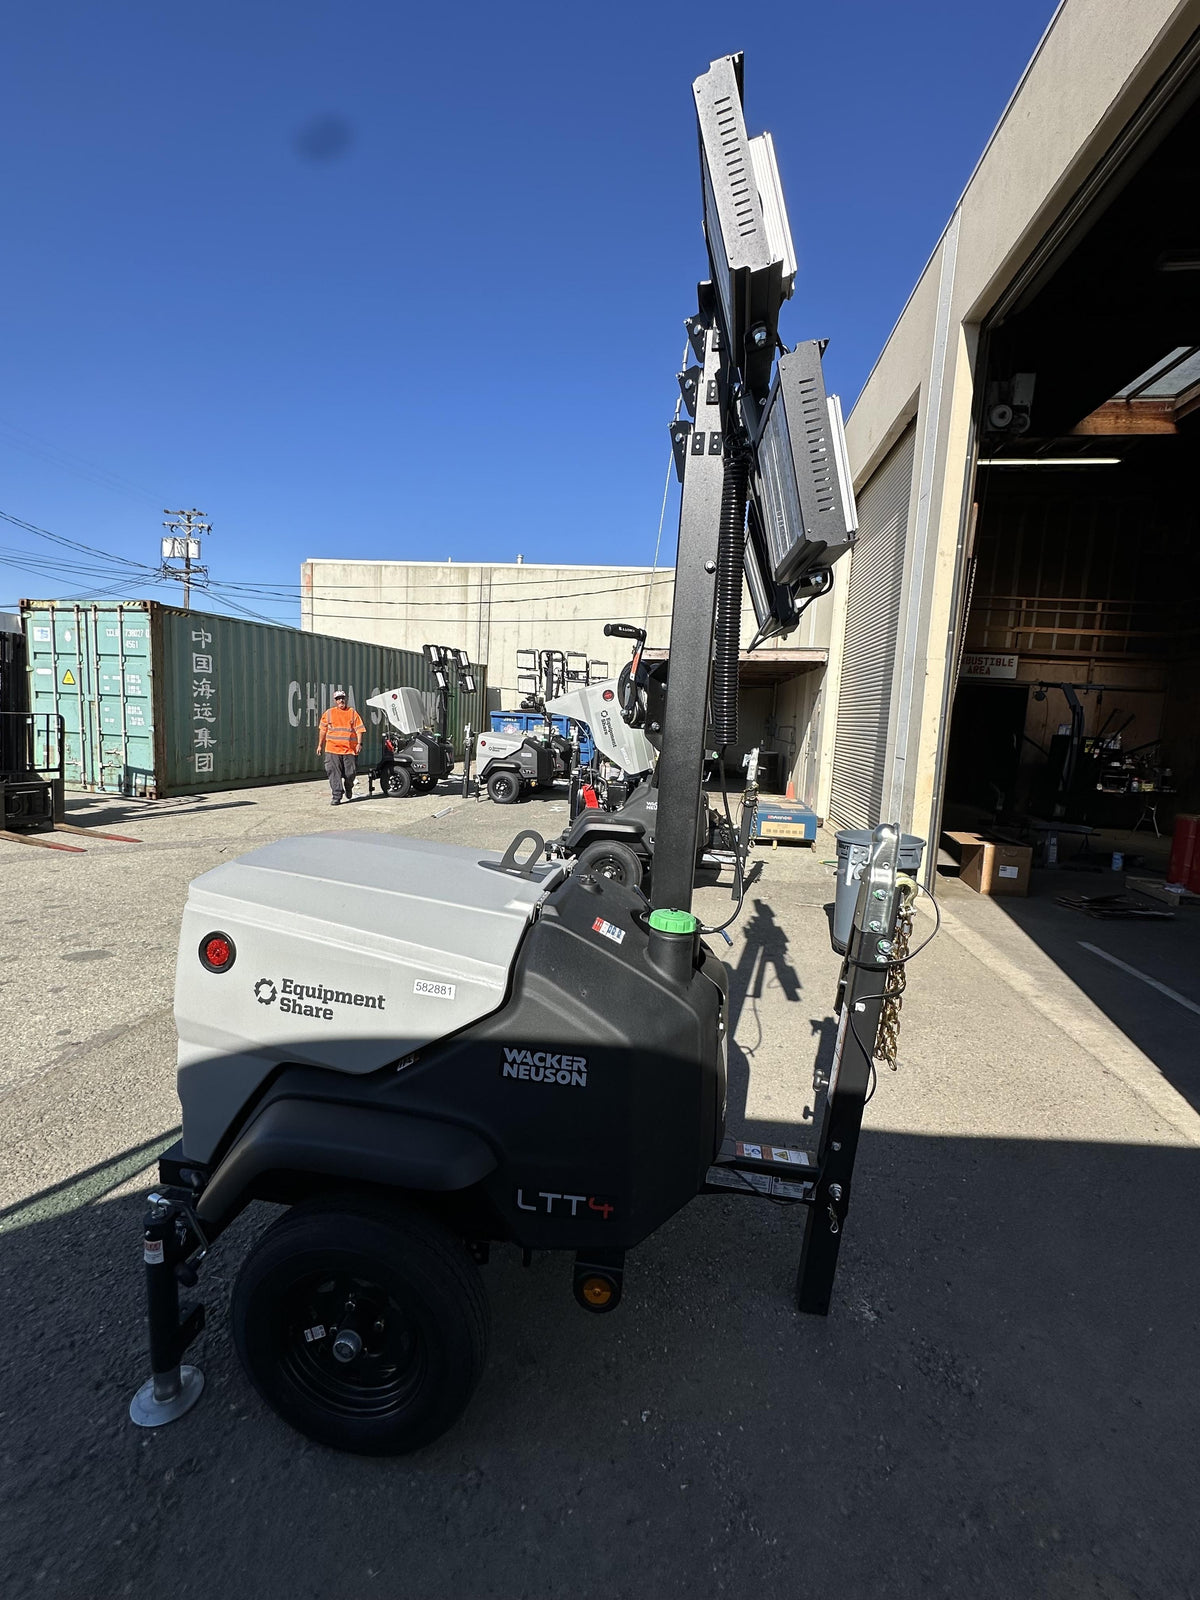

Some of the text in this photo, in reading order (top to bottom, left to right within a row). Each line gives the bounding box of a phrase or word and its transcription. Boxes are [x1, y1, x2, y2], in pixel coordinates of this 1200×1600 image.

[967, 665, 991, 676] AREA
[280, 978, 386, 1010] Equipment
[415, 981, 453, 996] 582881
[279, 997, 334, 1020] Share
[503, 1047, 588, 1072] WACKER
[502, 1062, 587, 1087] NEUSON
[517, 1188, 614, 1219] LTT4
